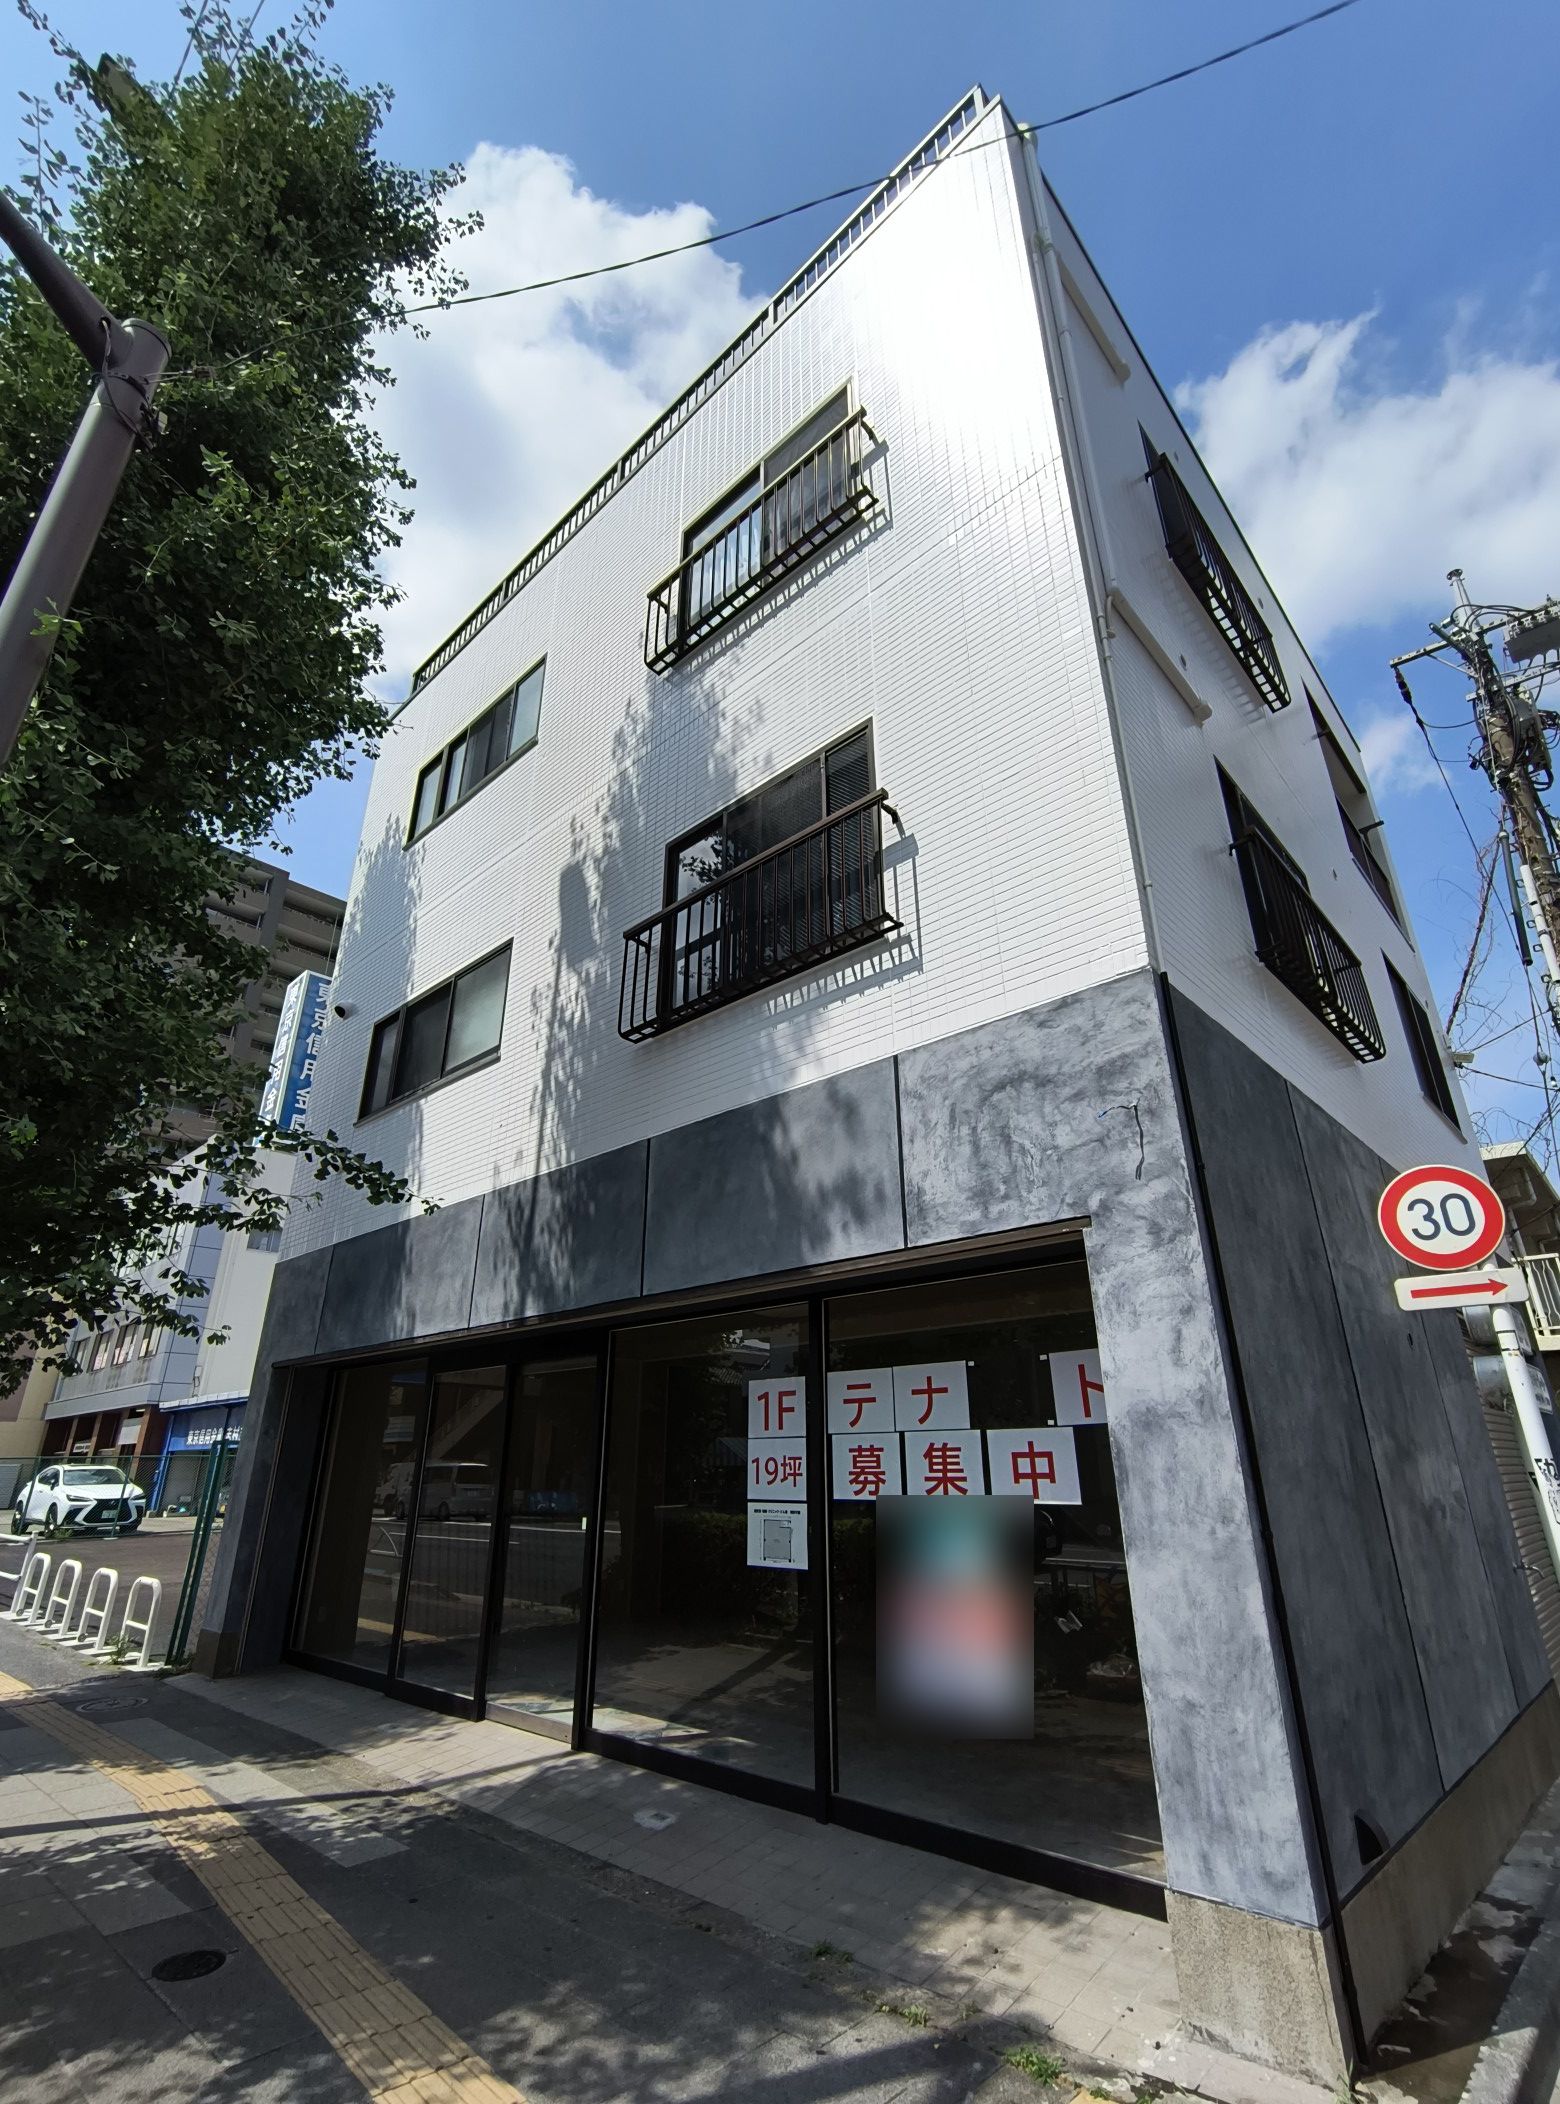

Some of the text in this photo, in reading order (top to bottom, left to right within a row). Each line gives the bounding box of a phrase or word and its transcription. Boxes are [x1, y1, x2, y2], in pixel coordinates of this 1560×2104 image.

[1407, 1193, 1476, 1240] 30
[757, 1389, 797, 1431] 1F
[751, 1455, 803, 1487] 19坪
[848, 1440, 1057, 1500] 募集中
